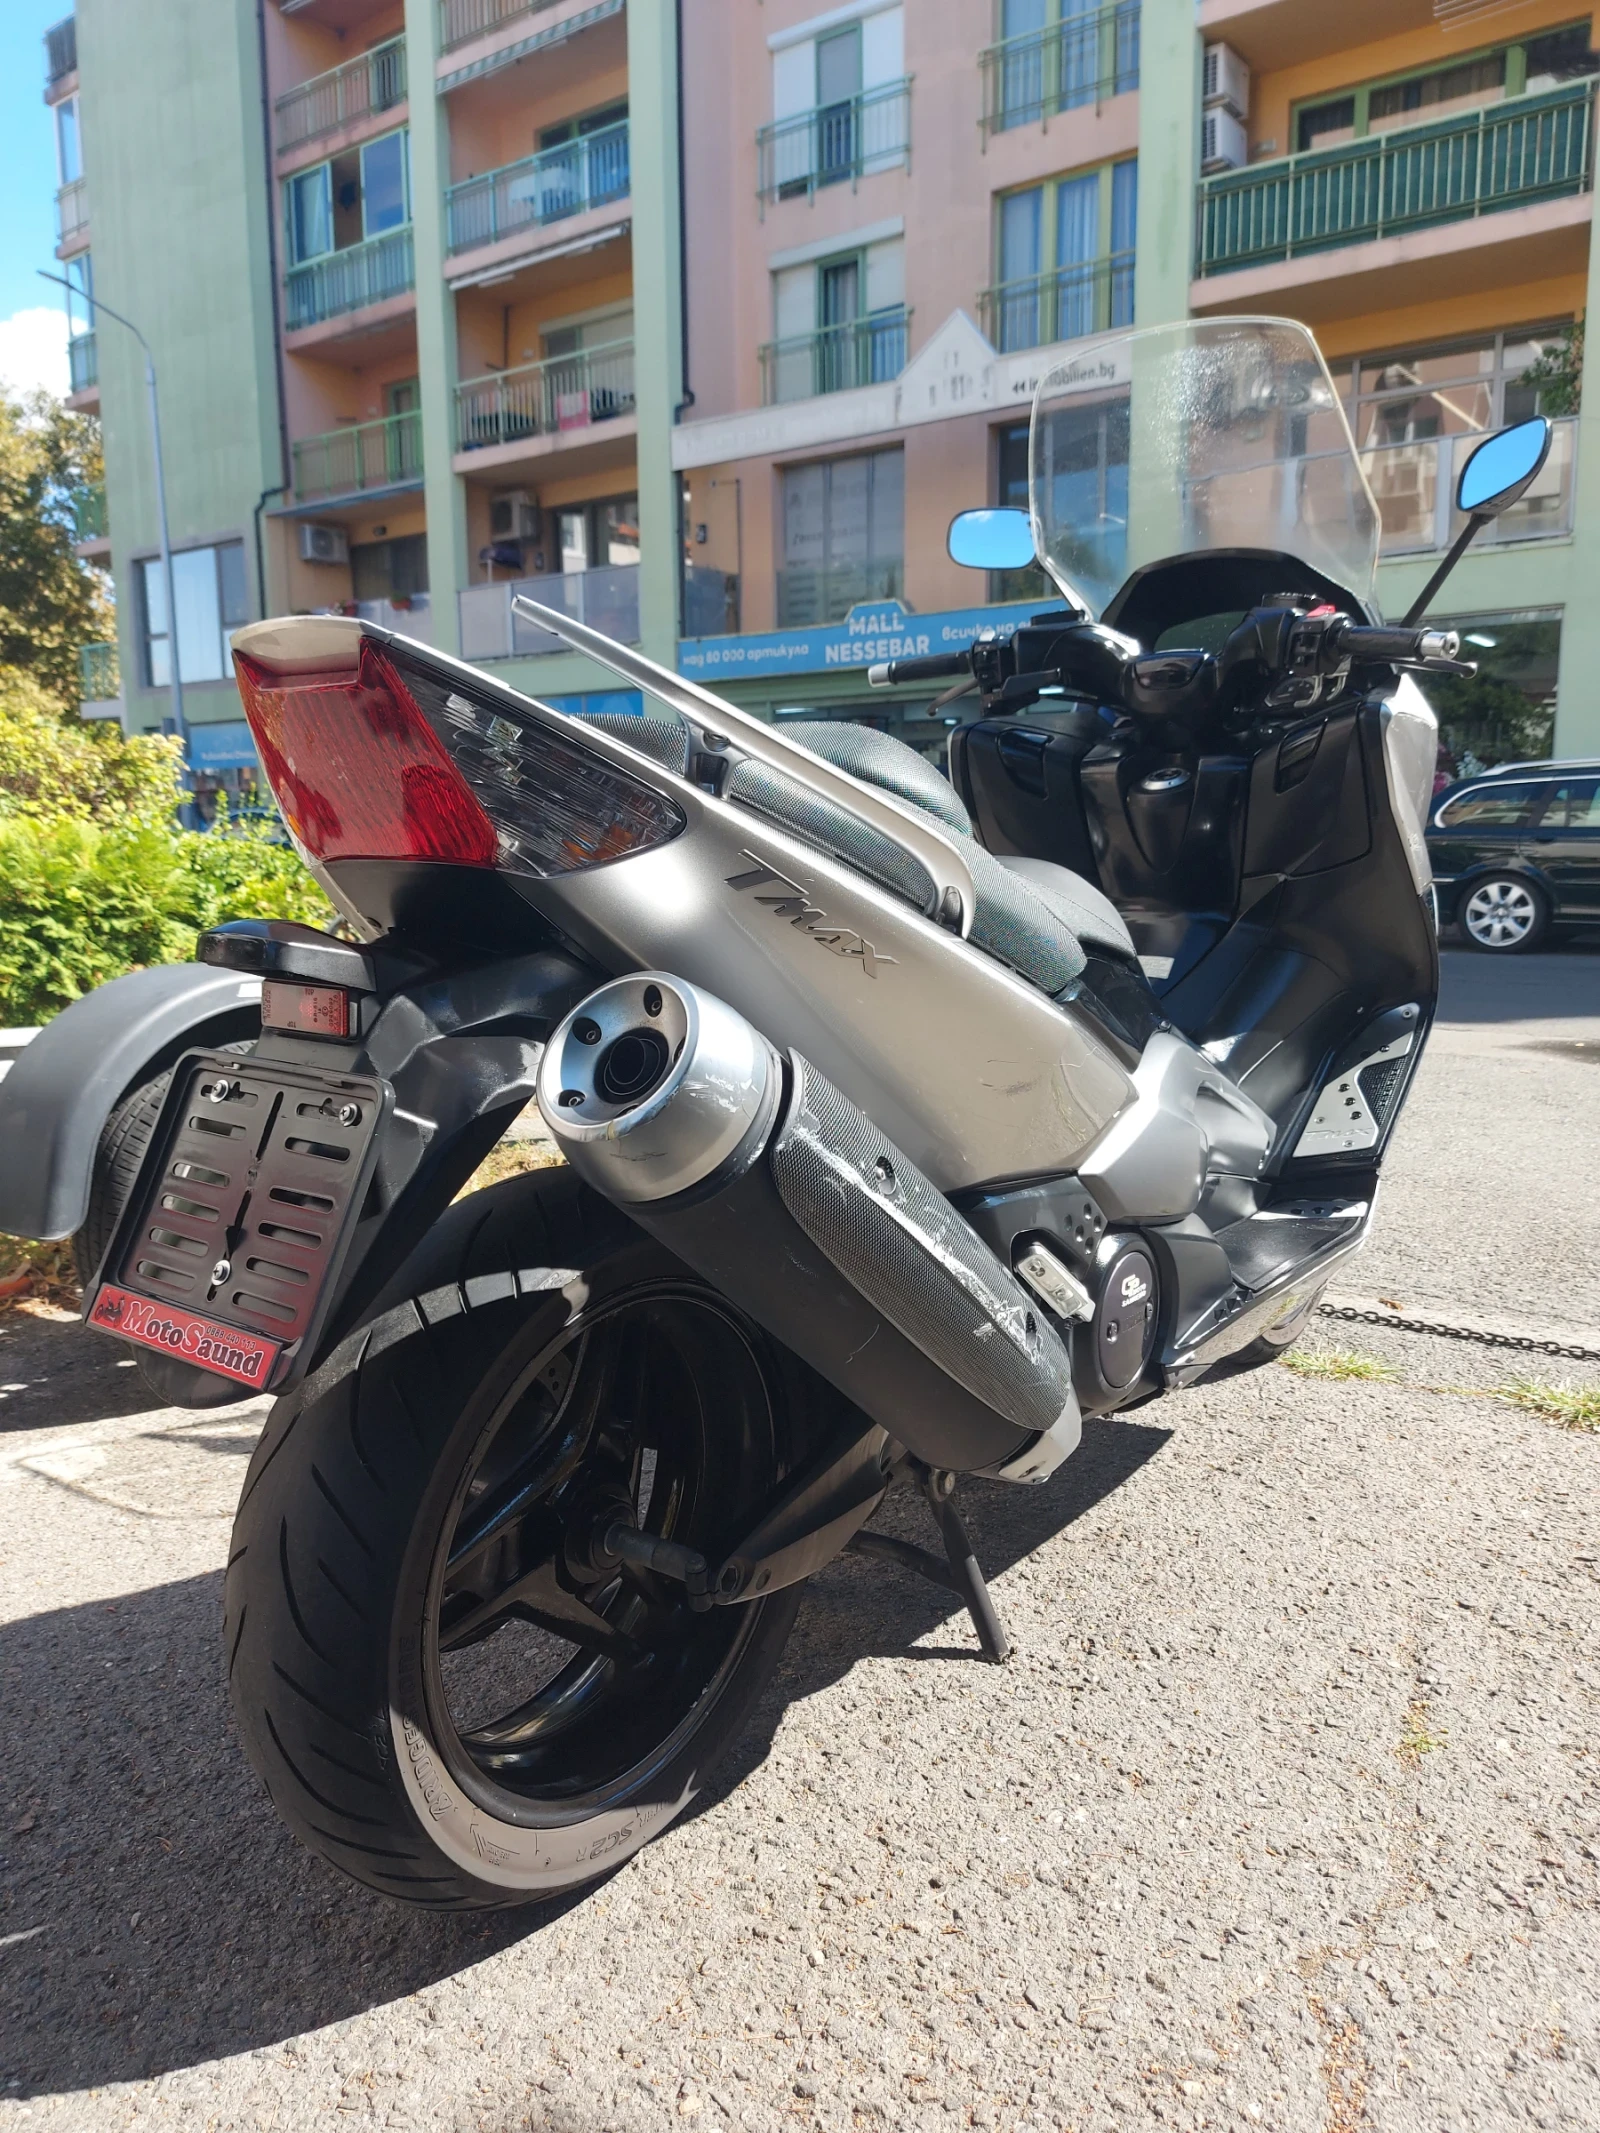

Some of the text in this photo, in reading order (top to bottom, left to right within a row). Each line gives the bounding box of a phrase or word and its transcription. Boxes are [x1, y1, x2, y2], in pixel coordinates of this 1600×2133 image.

[1029, 361, 1115, 392] iobilien.bg
[848, 612, 904, 636] MALL
[721, 648, 745, 662] 000
[825, 634, 930, 664] NESSEBAR
[122, 1301, 264, 1378] MotoSaund
[225, 1332, 240, 1345] 440
